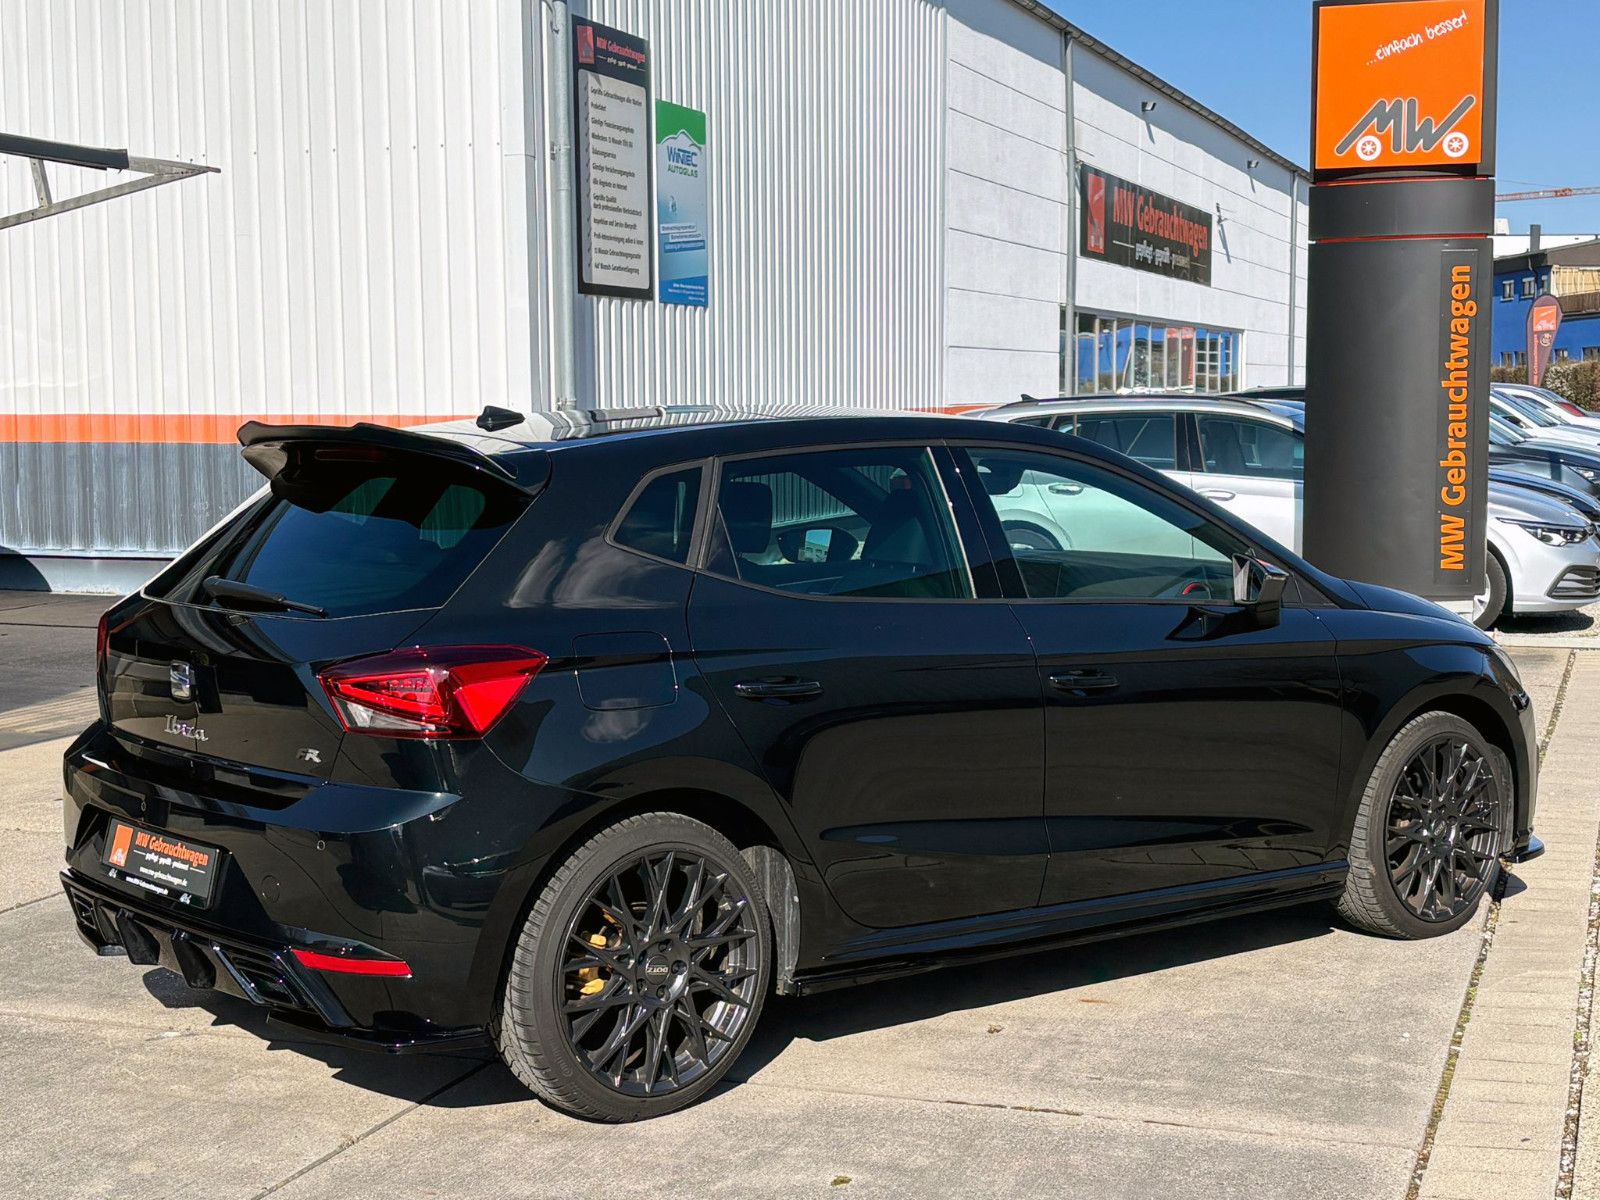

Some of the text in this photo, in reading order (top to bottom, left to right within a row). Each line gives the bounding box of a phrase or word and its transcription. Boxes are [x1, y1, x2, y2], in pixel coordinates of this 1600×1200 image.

[1425, 10, 1468, 40] besser!
[1335, 94, 1476, 156] MW
[667, 164, 699, 178] AUTOGLAS
[1113, 186, 1208, 257] MW Gebrauchtwagen
[1440, 264, 1477, 570] MW Gebrauchtwagen
[164, 714, 209, 742] Ibiza
[135, 831, 209, 867] MW Gebrauchtwagen
